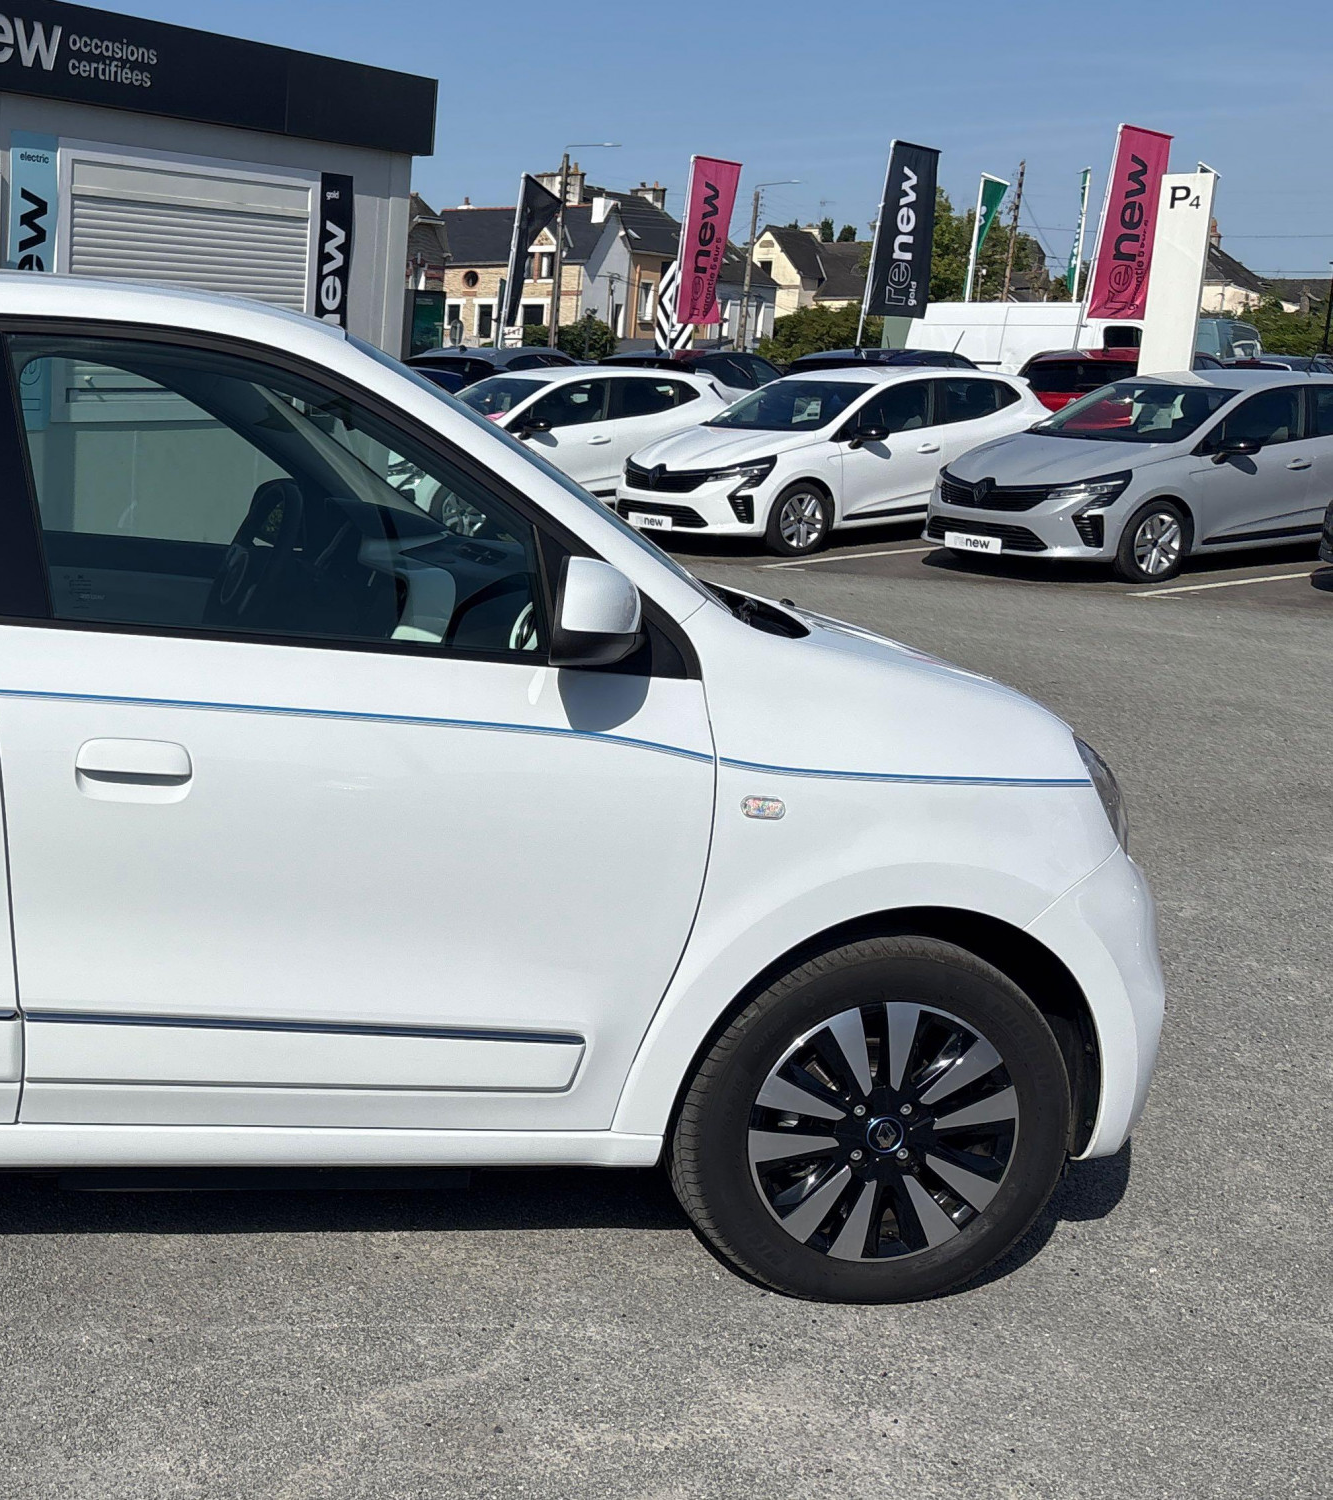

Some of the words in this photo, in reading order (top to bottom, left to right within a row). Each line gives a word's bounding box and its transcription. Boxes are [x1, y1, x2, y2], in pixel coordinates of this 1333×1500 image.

[68, 33, 158, 65] occasions
[68, 57, 152, 88] certifiées
[19, 152, 50, 164] electric
[326, 190, 340, 200] gold
[885, 166, 918, 305] renew
[1104, 154, 1148, 317] renew
[908, 281, 917, 306] gold
